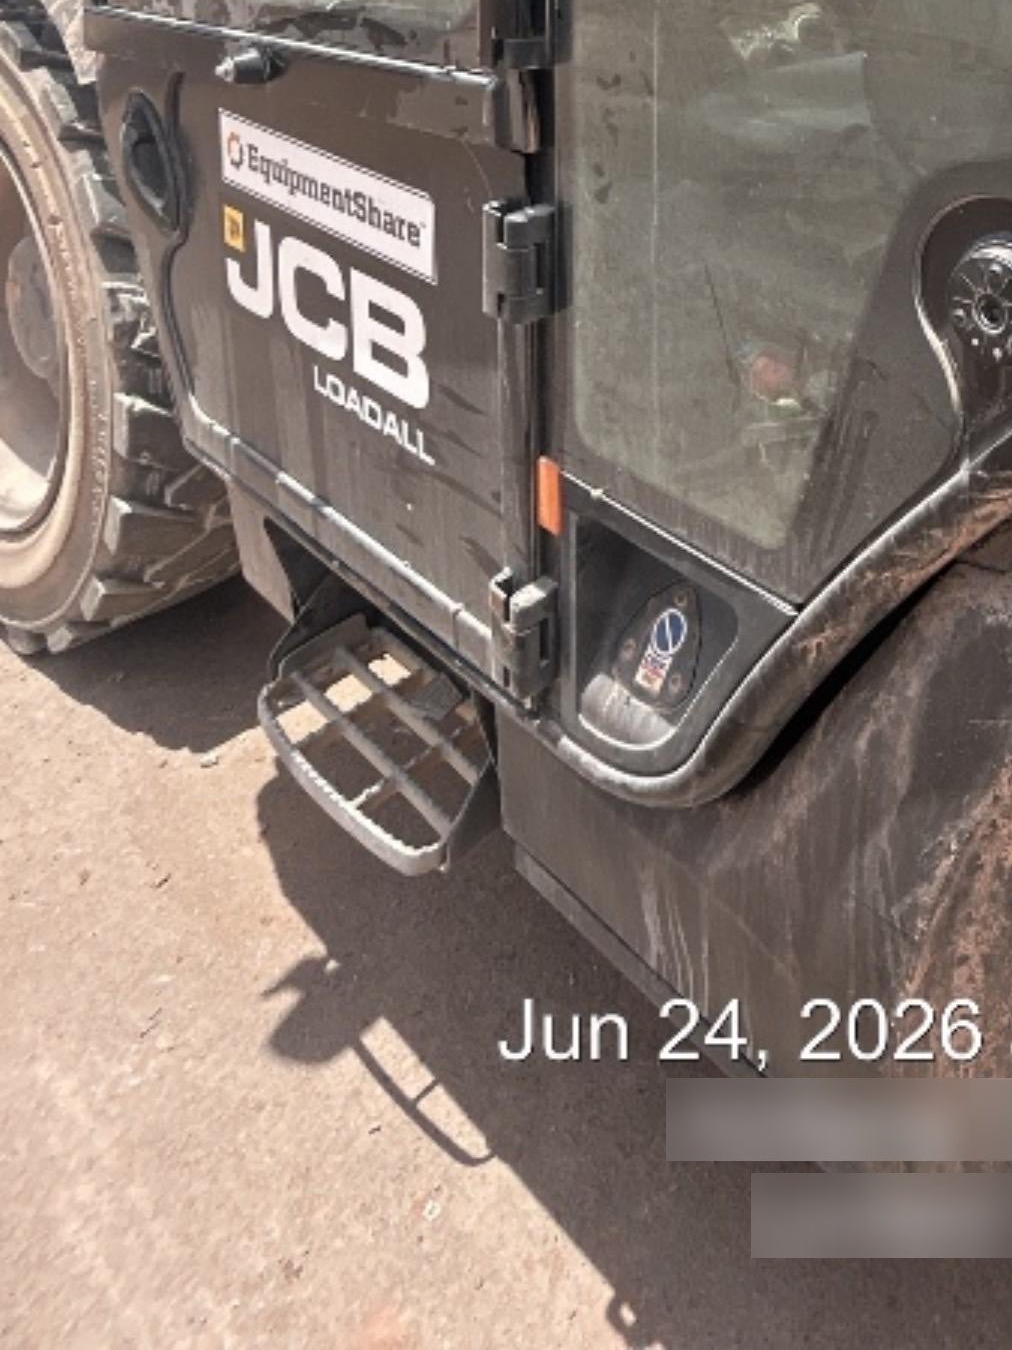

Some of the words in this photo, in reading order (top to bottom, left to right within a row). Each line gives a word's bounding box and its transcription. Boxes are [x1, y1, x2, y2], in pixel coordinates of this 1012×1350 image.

[246, 143, 423, 247] EquipmentShare
[226, 219, 430, 409] JCB
[314, 365, 436, 465] LOADALL
